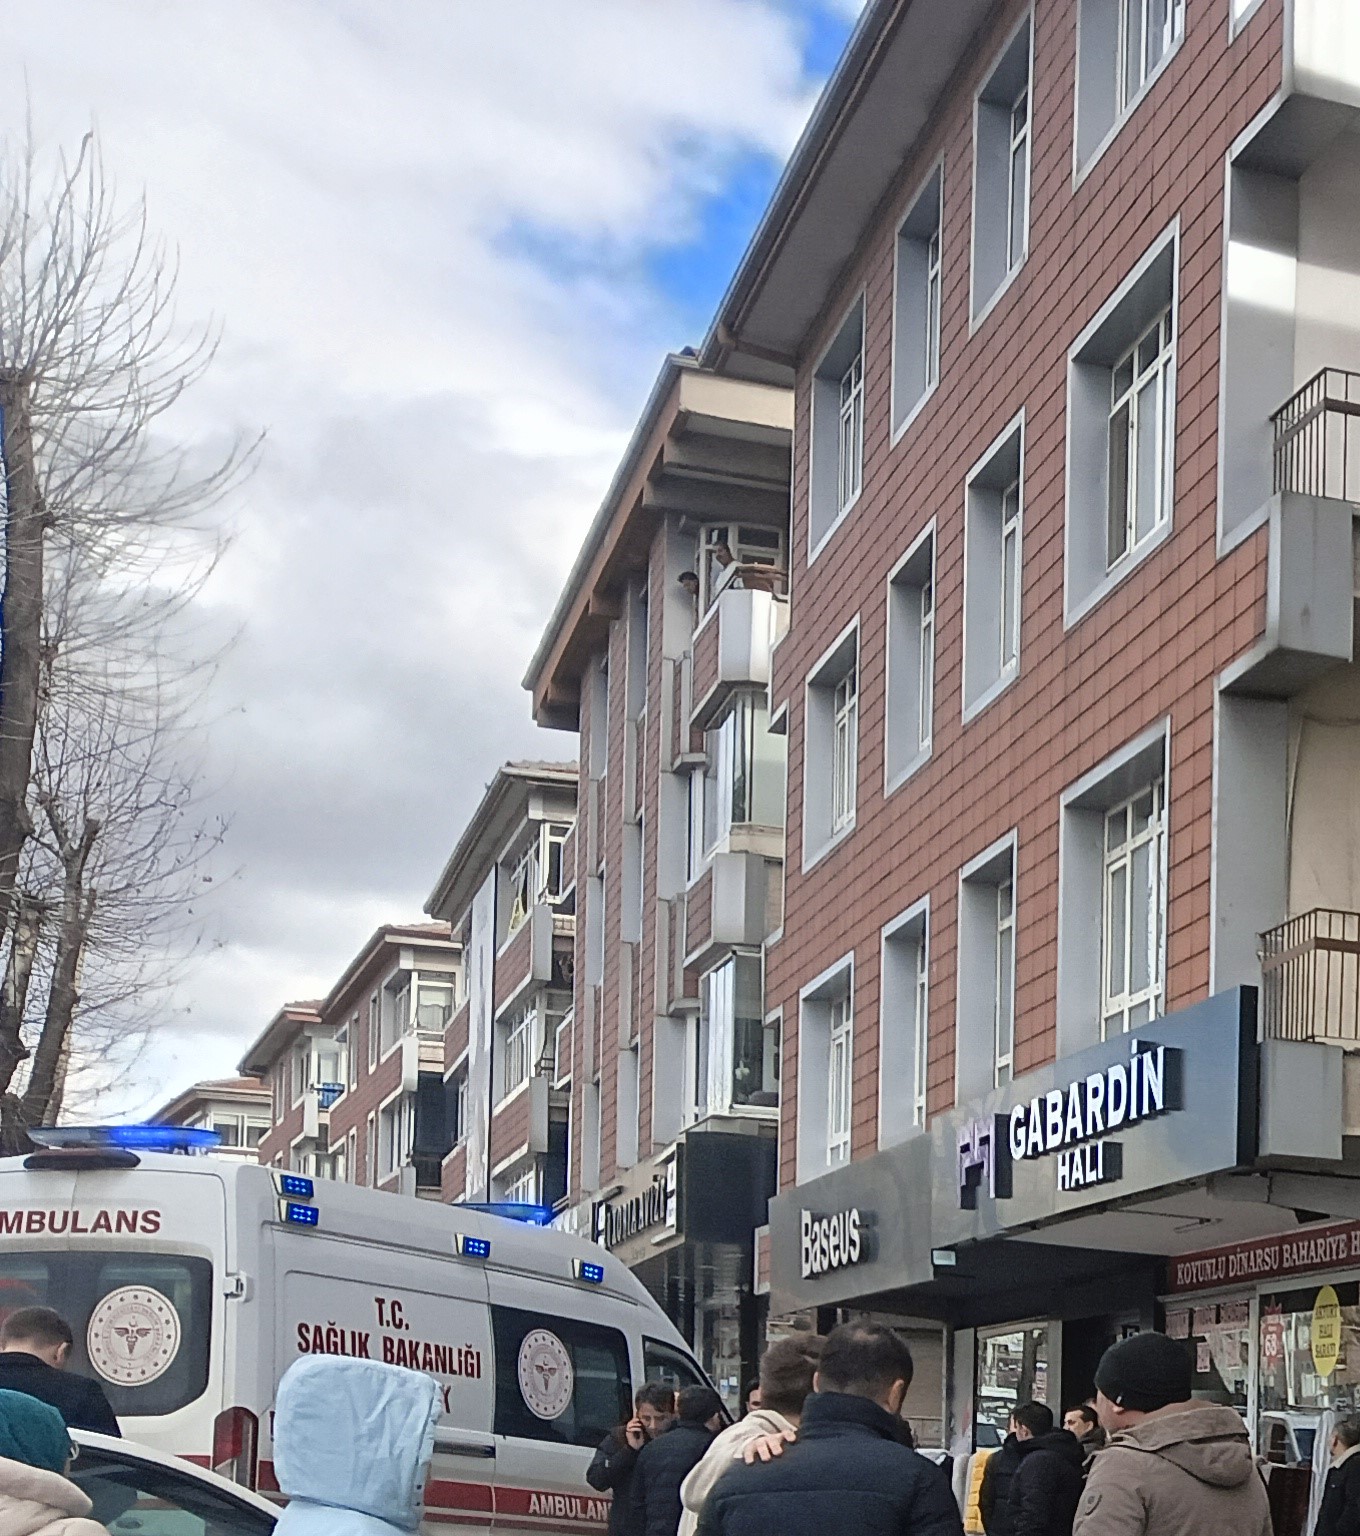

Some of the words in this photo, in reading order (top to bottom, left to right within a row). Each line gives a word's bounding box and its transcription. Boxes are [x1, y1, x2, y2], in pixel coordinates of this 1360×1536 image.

[1009, 1038, 1165, 1161] GABARDİN
[1057, 1140, 1104, 1191] HALI
[801, 1207, 861, 1279] Baseus
[1283, 1231, 1347, 1269] BAHARİYE
[374, 1296, 410, 1331] T.C.
[297, 1320, 371, 1360] SAĞLIK
[528, 1492, 613, 1522] AMBULAN
